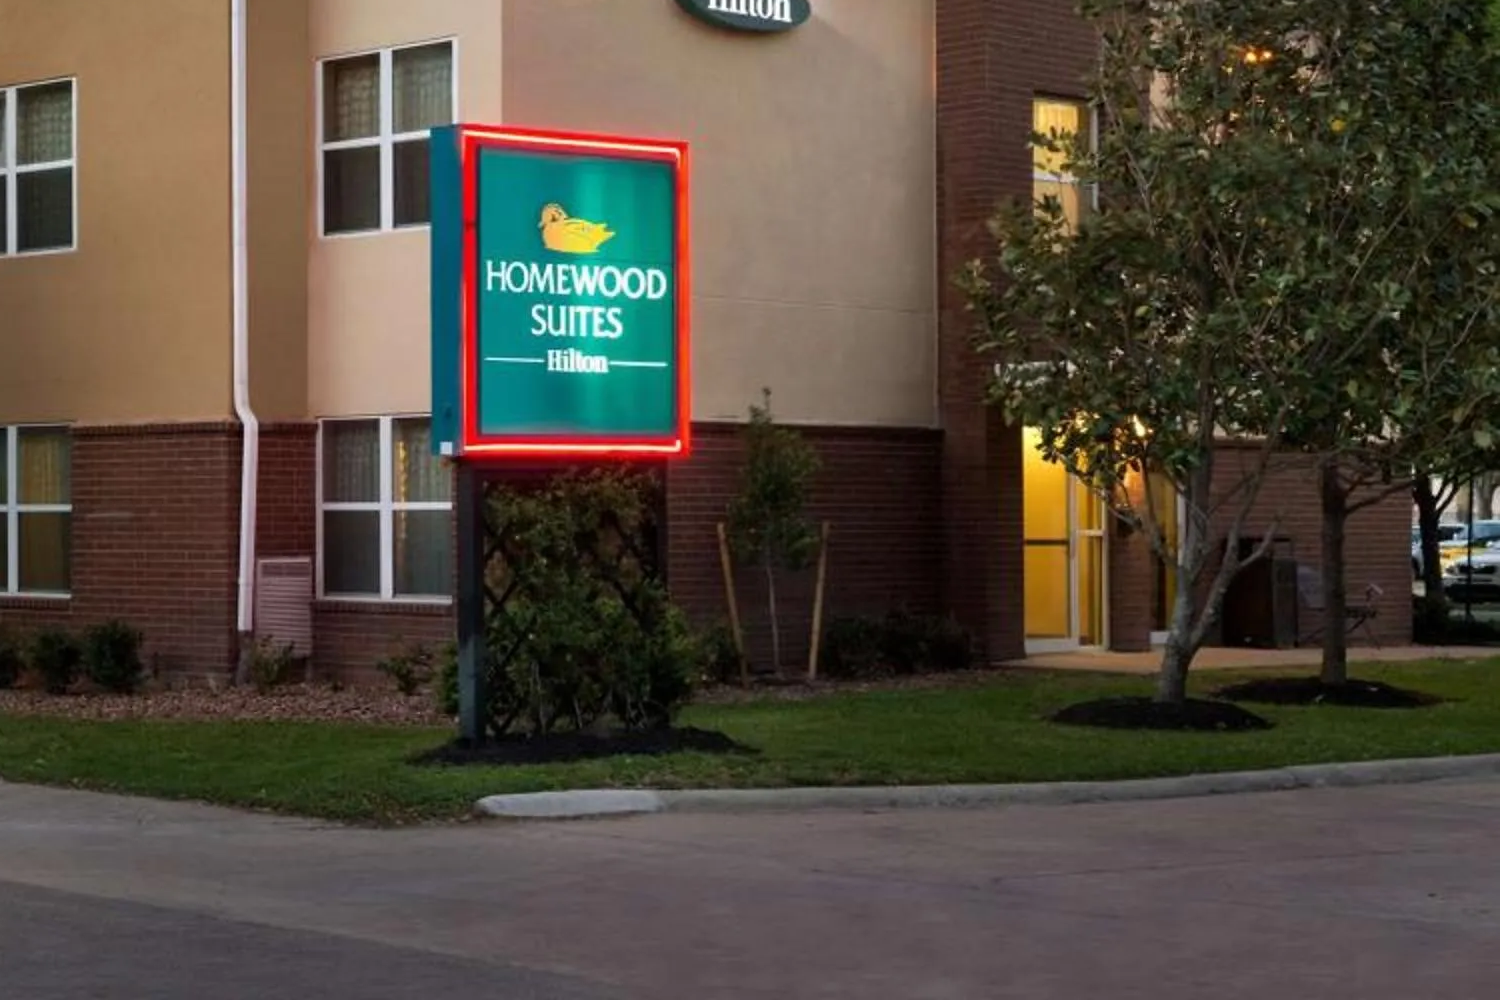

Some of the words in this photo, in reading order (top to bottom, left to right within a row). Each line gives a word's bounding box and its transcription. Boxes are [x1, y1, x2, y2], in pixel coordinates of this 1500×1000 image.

[486, 260, 668, 299] HOMEWOOD
[531, 304, 624, 338] SUITES
[547, 348, 609, 373] Hilton
